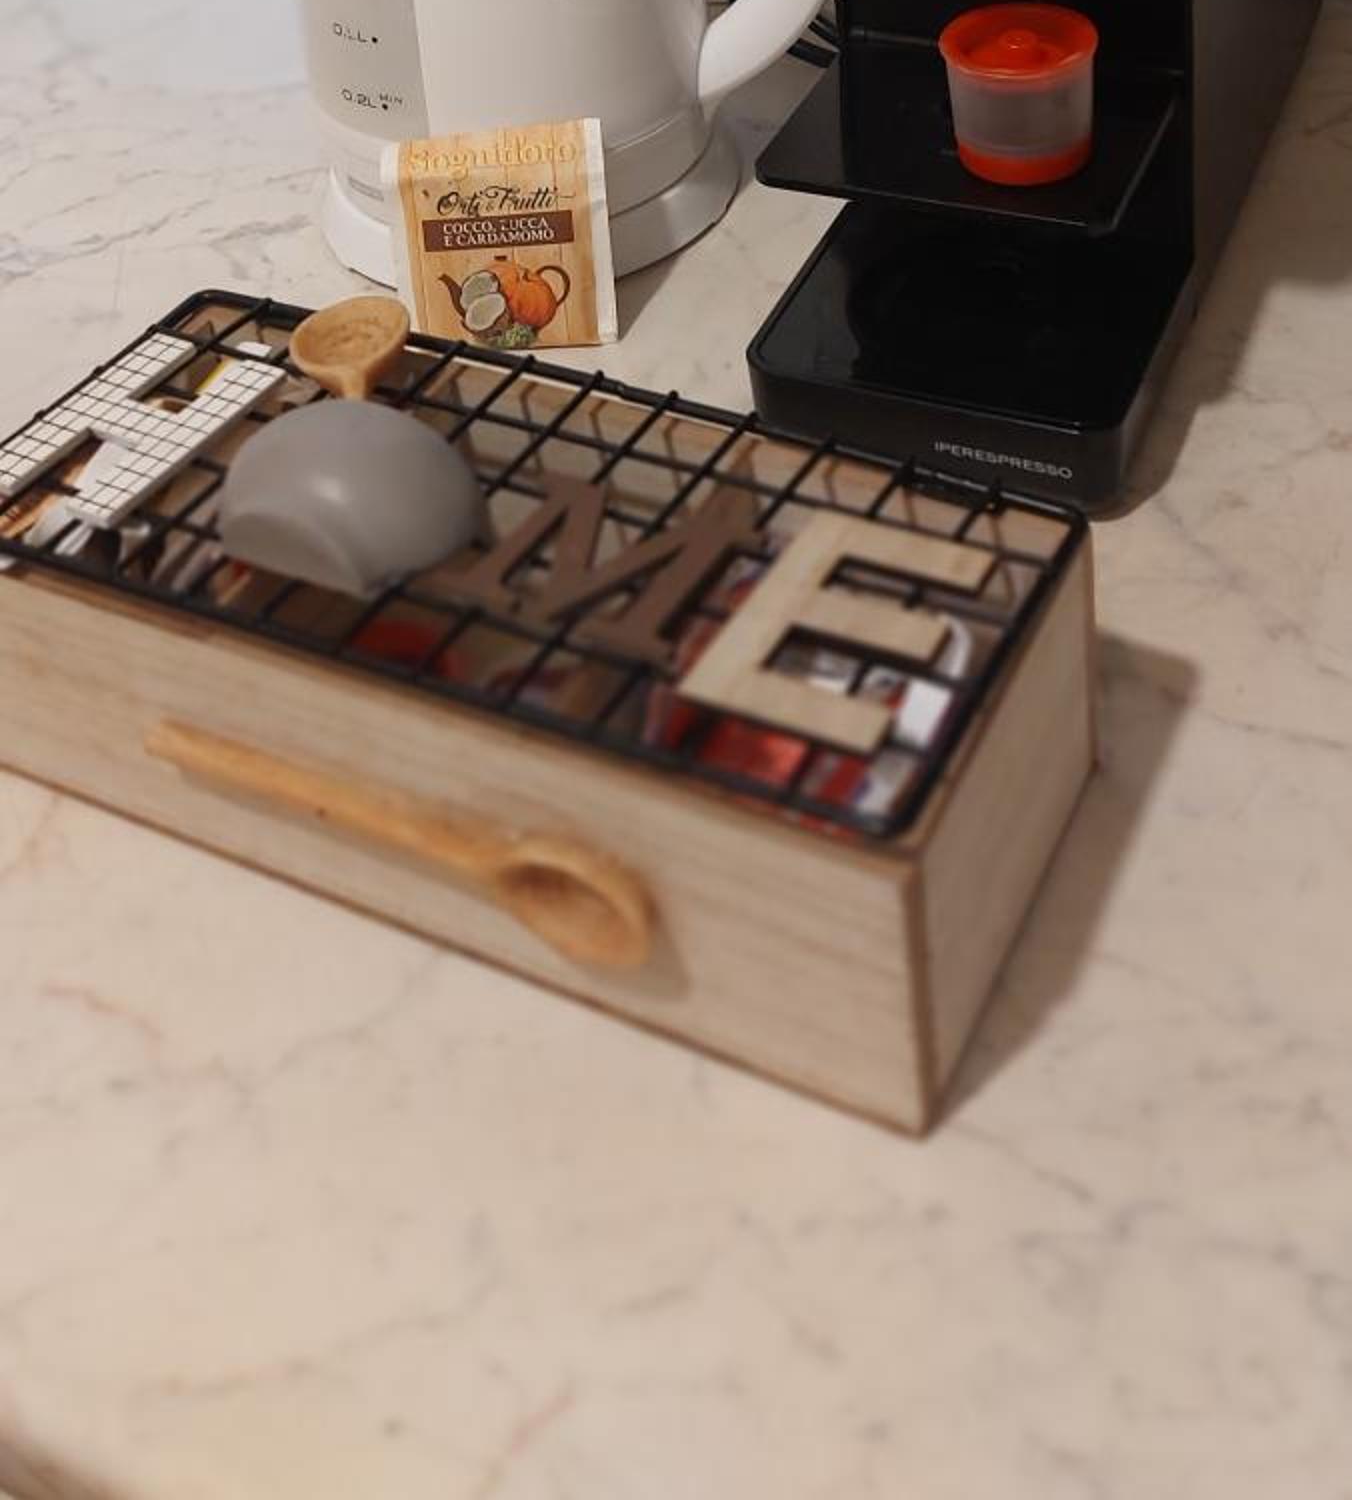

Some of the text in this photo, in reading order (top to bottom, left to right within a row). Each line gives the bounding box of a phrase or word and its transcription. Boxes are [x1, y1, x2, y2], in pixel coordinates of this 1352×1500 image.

[341, 88, 377, 109] 0.2L
[457, 228, 554, 246] CARDAMOMO
[934, 441, 1073, 480] IPERESPRESSO
